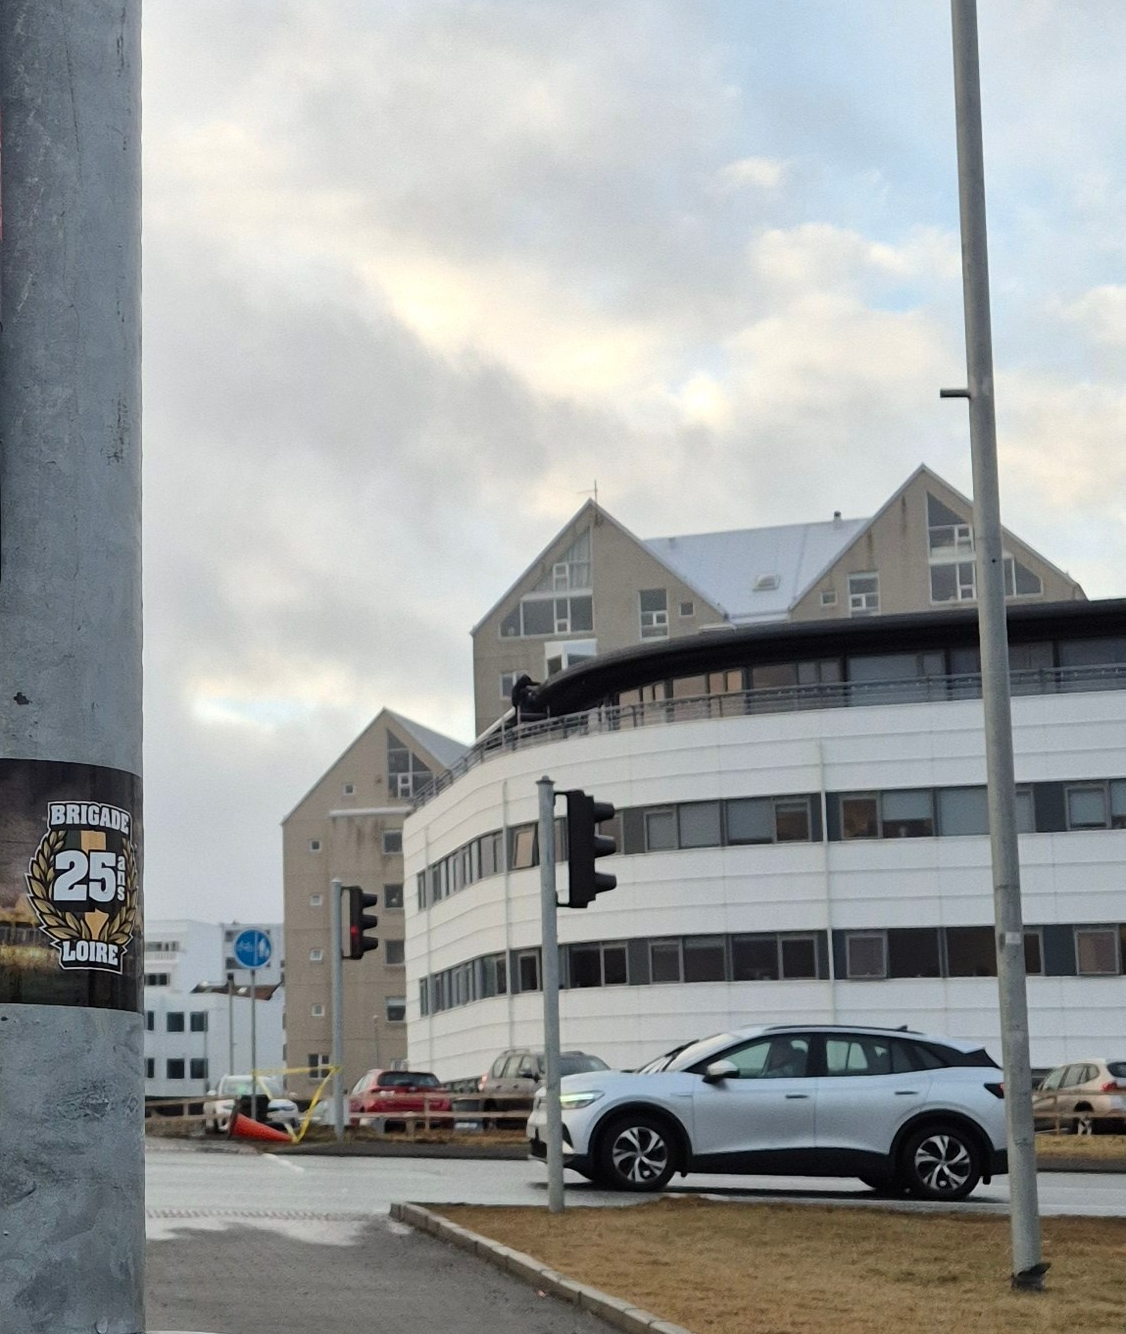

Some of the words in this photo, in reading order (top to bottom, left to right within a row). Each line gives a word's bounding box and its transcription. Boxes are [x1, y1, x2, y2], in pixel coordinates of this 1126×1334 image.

[50, 803, 130, 835] BRIGADE
[53, 849, 117, 902] 25
[117, 855, 126, 902] ans
[62, 940, 119, 966] LOIRE
